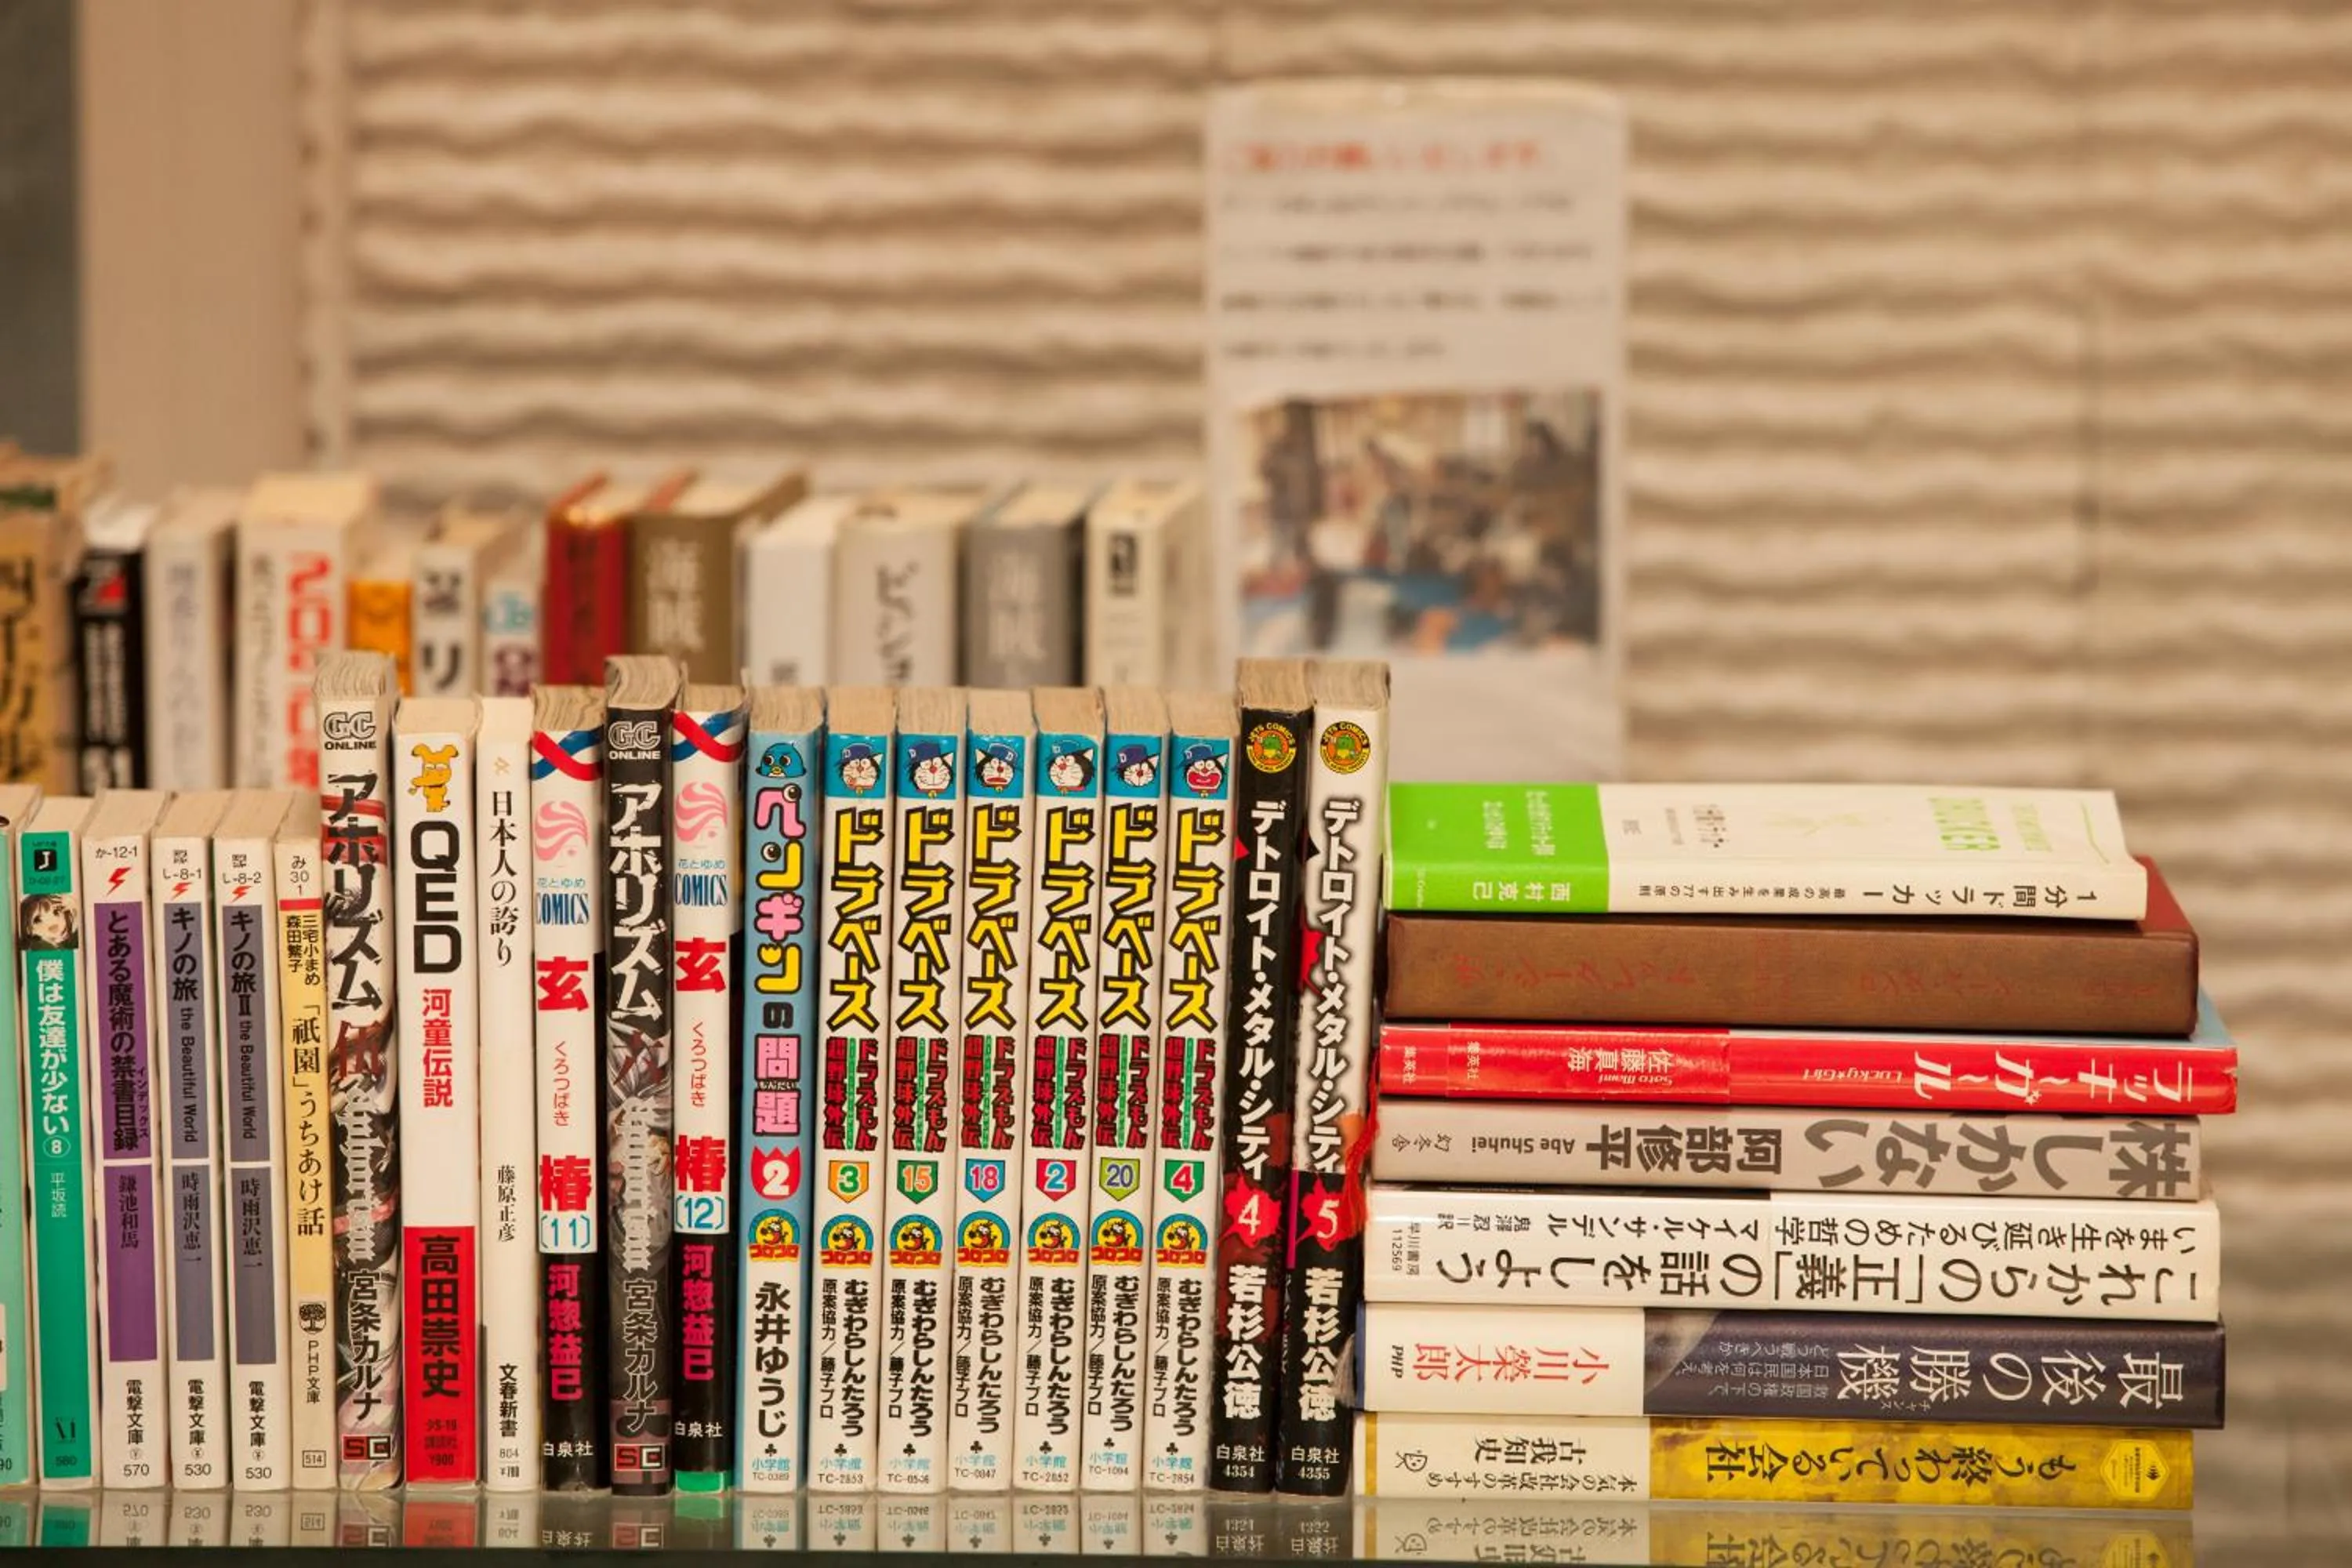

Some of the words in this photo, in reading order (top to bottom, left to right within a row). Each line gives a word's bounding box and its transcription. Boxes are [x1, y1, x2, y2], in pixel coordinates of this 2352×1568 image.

[324, 740, 377, 751] ONLINE
[608, 750, 661, 760] ONLINE
[1265, 722, 1297, 745] COMICS
[1339, 722, 1371, 746] COMICS
[289, 870, 309, 883] 30
[489, 789, 518, 967] 日本人の誇り
[537, 877, 586, 888] 花とゆめ
[678, 858, 727, 869] 花とゆめ
[324, 772, 384, 1011] アホリズム
[410, 820, 463, 973] QED
[535, 892, 590, 926] COMICS
[608, 782, 666, 1020] アホリズム
[674, 873, 728, 908] COMICS
[1472, 880, 1571, 902] 西村克己
[1638, 884, 1846, 900] 最高の成果を生み出す77の原則
[1863, 883, 2099, 909] 1分間ドラッカー
[826, 807, 885, 1033] ドラベース
[895, 806, 955, 1033] ドラベース
[964, 803, 1022, 1030] ドラベース
[1034, 806, 1096, 1032] ドラベース
[1100, 803, 1159, 1030] ドラベース
[1166, 807, 1226, 1033] ドラベース
[170, 907, 198, 1003] キノの旅
[286, 915, 303, 972] 森田繁子
[302, 915, 321, 985] 三宅小まめ
[674, 937, 727, 993] 玄
[536, 956, 590, 1012] 玄
[1236, 800, 1287, 1180] デトロイト・メタル・シティ
[1308, 800, 1361, 1174] デトロイト・メタル・シティ
[107, 911, 139, 1152] とある魔術の禁書目録
[180, 1007, 194, 1031] the
[238, 1021, 252, 1041] the
[36, 958, 68, 1136] 僕は友達が少ない
[181, 1036, 197, 1099] Beautiful
[422, 988, 454, 1108] 河童伝説
[690, 1021, 708, 1108] くろつばき
[1466, 1040, 1481, 1080] 集英社
[1567, 1046, 1674, 1073] 佐藤真海
[240, 1044, 256, 1102] Beautiful
[554, 1040, 571, 1127] くろつばき
[1914, 1050, 2194, 1104] ラッキーガール
[183, 1103, 198, 1143] World
[242, 1105, 257, 1140] World
[1471, 1136, 1535, 1154] Shuhei
[1540, 1136, 1577, 1155] Abe
[674, 1134, 727, 1193] 椿
[1585, 1123, 1784, 1176] 阿部修平
[1803, 1118, 2192, 1198] 株しかない
[539, 1154, 592, 1212] 椿
[762, 1159, 791, 1196] 2
[838, 1163, 861, 1194] 3
[902, 1164, 932, 1193] 15
[969, 1163, 1000, 1192] 18
[1045, 1163, 1068, 1192] 2
[1105, 1163, 1134, 1189] 20
[1172, 1163, 1194, 1193] 4
[118, 1172, 140, 1250] 鎌池和馬
[181, 1172, 201, 1264] 時雨沢恵一
[240, 1178, 263, 1269] 時雨沢恵一
[1238, 1194, 1261, 1236] 4
[1316, 1199, 1341, 1240] 5
[1546, 1211, 1760, 1243] マイケル・サンデル
[1773, 1215, 2197, 1255] いまを生き延びるための哲学
[748, 1243, 800, 1260] コロコロ
[820, 1249, 873, 1266] コロコロ
[890, 1249, 942, 1266] コロコロ
[956, 1247, 1011, 1265] コロコロ
[1027, 1247, 1081, 1265] コロコロ
[1090, 1246, 1144, 1264] コロコロ
[1155, 1247, 1208, 1265] コロコロ
[1390, 1228, 1404, 1273] 112569
[1436, 1248, 2198, 1307] これからの「正義」の話をしよう
[419, 1234, 461, 1399] 高田崇史
[347, 1269, 383, 1422] 宮条カルナ
[622, 1279, 659, 1433] 宮条カルナ
[753, 1281, 792, 1439] 永井ゆうじ
[841, 1278, 869, 1438] むぎわらしんたろう
[909, 1278, 938, 1438] むぎわらしんたろう
[975, 1276, 1007, 1435] むぎわらしんたろう
[1046, 1276, 1076, 1436] むぎわらしんたろう
[1109, 1275, 1141, 1433] むぎわらしんたろう
[1172, 1278, 1203, 1437] むぎわらしんたろう
[1222, 1264, 1268, 1421] 若杉公徳
[1298, 1266, 1345, 1421] 若杉公徳
[1391, 1344, 1405, 1379] PHP
[1412, 1342, 1610, 1385] 小川榮太郎
[305, 1339, 321, 1404] PHP文庫
[1835, 1342, 2186, 1410] 最後の勝機
[125, 1378, 143, 1446] 電撃文庫
[187, 1378, 205, 1446] 電撃文庫
[249, 1381, 267, 1447] 電撃文庫
[498, 1363, 519, 1438] 文春新書
[1880, 1398, 1933, 1415] チャンス
[543, 1441, 594, 1457] 白泉社
[673, 1421, 724, 1439] 白泉社
[1215, 1443, 1266, 1463] 白泉社
[1474, 1436, 1588, 1467] 古我知史
[123, 1463, 150, 1476] 570
[184, 1463, 212, 1476] 530
[245, 1466, 272, 1479] 530
[1290, 1447, 1341, 1465] 白泉社
[1704, 1441, 2077, 1489] もう終わっている会社
[1427, 1470, 1639, 1494] 本気の会社改革のすすめ
